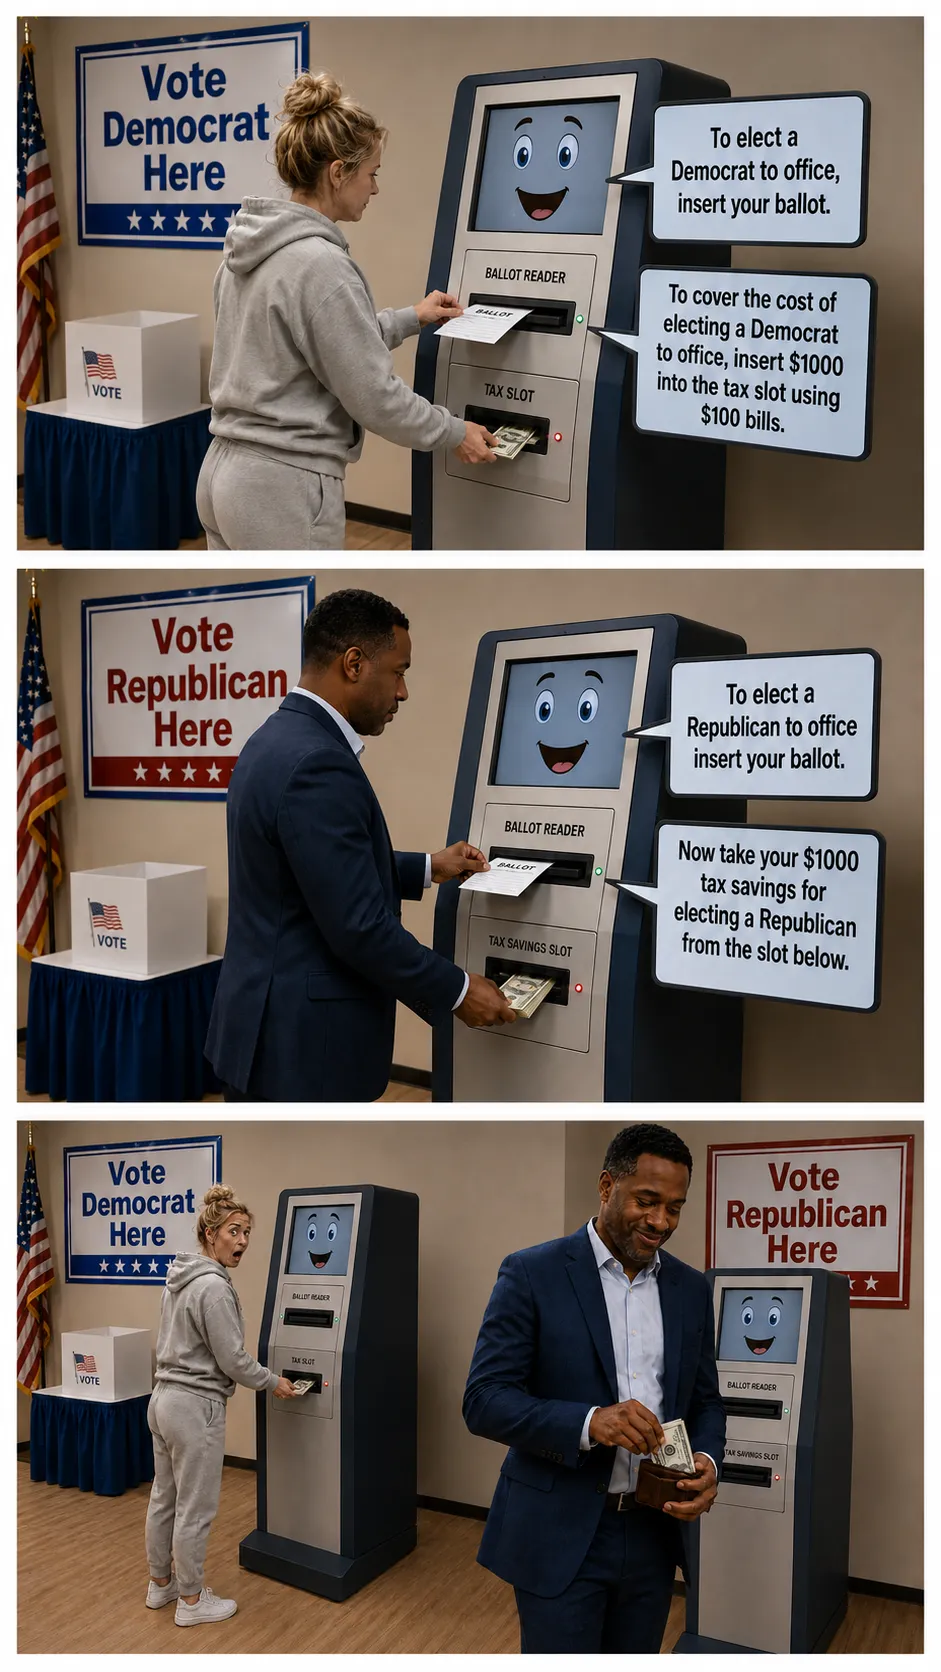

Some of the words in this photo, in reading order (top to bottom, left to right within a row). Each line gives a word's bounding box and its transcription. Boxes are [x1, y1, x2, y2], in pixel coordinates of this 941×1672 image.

[141, 62, 226, 101] Vote
[103, 103, 270, 147] Democrat
[710, 126, 731, 149] To
[736, 126, 782, 148] elect
[788, 131, 798, 147] a
[143, 154, 225, 191] Here
[671, 159, 755, 182] Democrat
[760, 161, 778, 181] to
[783, 158, 840, 184] office,
[678, 192, 726, 215] insert
[731, 196, 770, 218] your
[775, 192, 830, 214] ballot.
[485, 267, 522, 281] BALLOT
[523, 269, 566, 284] READER
[668, 283, 688, 304] To
[692, 287, 739, 308] cover
[743, 287, 771, 310] the
[776, 291, 813, 312] cost
[818, 291, 837, 313] of
[476, 309, 514, 318] BALLOT
[663, 315, 730, 341] electing
[735, 323, 746, 339] a
[750, 319, 839, 344] Democrat
[656, 344, 673, 363] to
[677, 344, 729, 370] office,
[733, 348, 784, 372] insert
[789, 351, 843, 377] $1000
[92, 384, 122, 400] VOTE
[484, 383, 504, 398] TAX
[506, 387, 535, 403] SLOT
[657, 372, 688, 393] into
[692, 374, 719, 395] the
[723, 378, 749, 398] tax
[754, 379, 787, 402] slot
[791, 383, 840, 412] using
[701, 404, 741, 427] $100
[745, 408, 785, 433] bills.
[152, 617, 234, 655] Vote
[107, 662, 287, 711] Republican
[726, 683, 747, 705] To
[752, 682, 798, 704] elect
[804, 687, 814, 703] a
[154, 710, 233, 747] Here
[687, 716, 780, 742] Republican
[785, 717, 803, 738] to
[807, 715, 857, 737] office
[693, 747, 742, 770] insert
[747, 752, 785, 773] your
[790, 747, 845, 770] ballot.
[504, 821, 542, 834] BALLOT
[543, 823, 585, 837] READER
[497, 862, 537, 871] BALLOT
[678, 840, 714, 863] Now
[719, 843, 756, 865] take
[760, 846, 798, 870] your
[803, 847, 859, 872] $1000
[701, 873, 726, 894] tax
[731, 877, 796, 901] savings
[801, 878, 826, 901] for
[674, 903, 739, 931] electing
[744, 912, 754, 928] a
[759, 908, 857, 938] Republican
[97, 933, 127, 950] VOTE
[489, 935, 506, 948] TAX
[507, 938, 546, 954] SAVINGS
[549, 944, 573, 957] SLOT
[682, 933, 720, 956] from
[725, 936, 751, 958] the
[756, 939, 789, 964] slot
[793, 942, 850, 971] below.
[108, 1160, 166, 1186] Vote
[768, 1162, 840, 1192] Vote
[81, 1189, 195, 1217] Democrat
[727, 1198, 887, 1233] Republican
[109, 1221, 166, 1247] Here
[767, 1234, 838, 1264] Here
[79, 1375, 100, 1387] VOTE
[727, 1381, 751, 1389] BALLOT
[752, 1383, 777, 1391] READER
